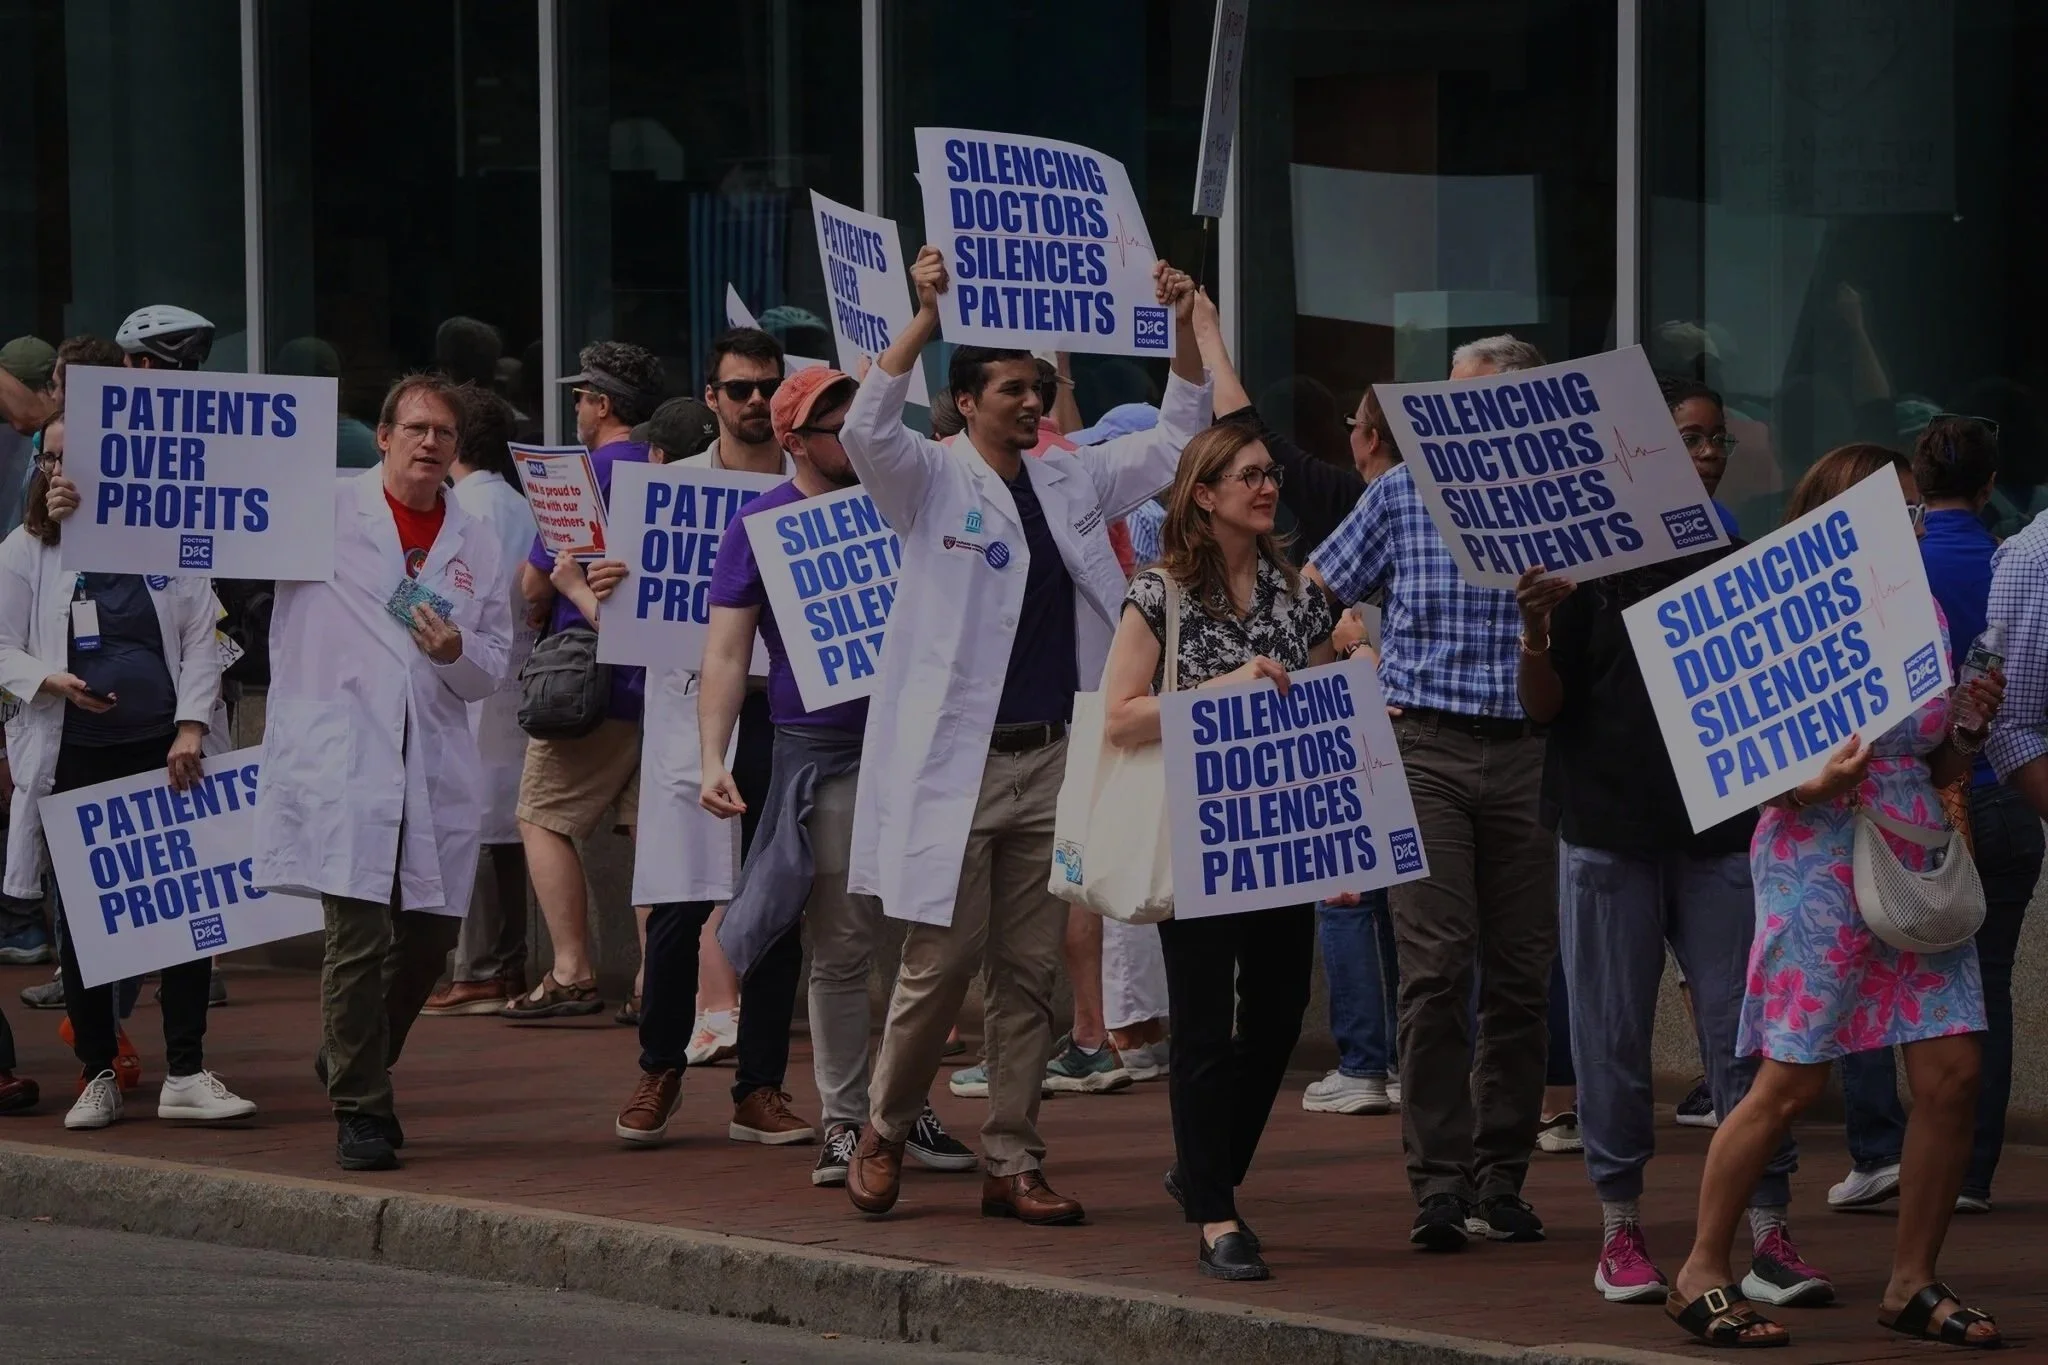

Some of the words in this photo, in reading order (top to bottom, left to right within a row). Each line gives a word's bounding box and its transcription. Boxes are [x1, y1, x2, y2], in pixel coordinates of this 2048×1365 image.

[945, 140, 1108, 195] SILENCING
[950, 188, 1108, 238] DOCTORS
[821, 211, 886, 273] PATIENTS
[955, 236, 1107, 286] SILENCES
[829, 255, 860, 305] OVER
[835, 297, 890, 352] PROFITS
[958, 285, 1115, 335] PATIENTS
[102, 386, 296, 437] PATIENTS
[1403, 372, 1600, 437] SILENCING
[101, 434, 205, 481] OVER
[1420, 422, 1604, 483] DOCTORS
[97, 482, 268, 532] PROFITS
[546, 485, 570, 497] proud
[571, 486, 581, 496] to
[547, 500, 562, 511] with
[563, 503, 578, 512] our
[1441, 470, 1615, 529] SILENCES
[1665, 508, 1701, 521] DOCTORS
[551, 516, 585, 527] brothers
[776, 495, 893, 555] SILEN
[1461, 512, 1643, 574] PATIENTS
[1677, 533, 1713, 545] COUNCIL
[1658, 511, 1858, 648] SILENCING
[1673, 568, 1861, 699] DOCTORS
[1192, 674, 1354, 745] SILENCING
[1691, 621, 1870, 747] SILENCES
[1706, 667, 1888, 797] PATIENTS
[1196, 726, 1356, 795] DOCTORS
[1199, 777, 1362, 845] SILENCES
[90, 829, 197, 889] OVER
[1203, 825, 1376, 895] PATIENTS
[192, 916, 220, 928] DOCTORS
[197, 937, 225, 948] COUNCIL
